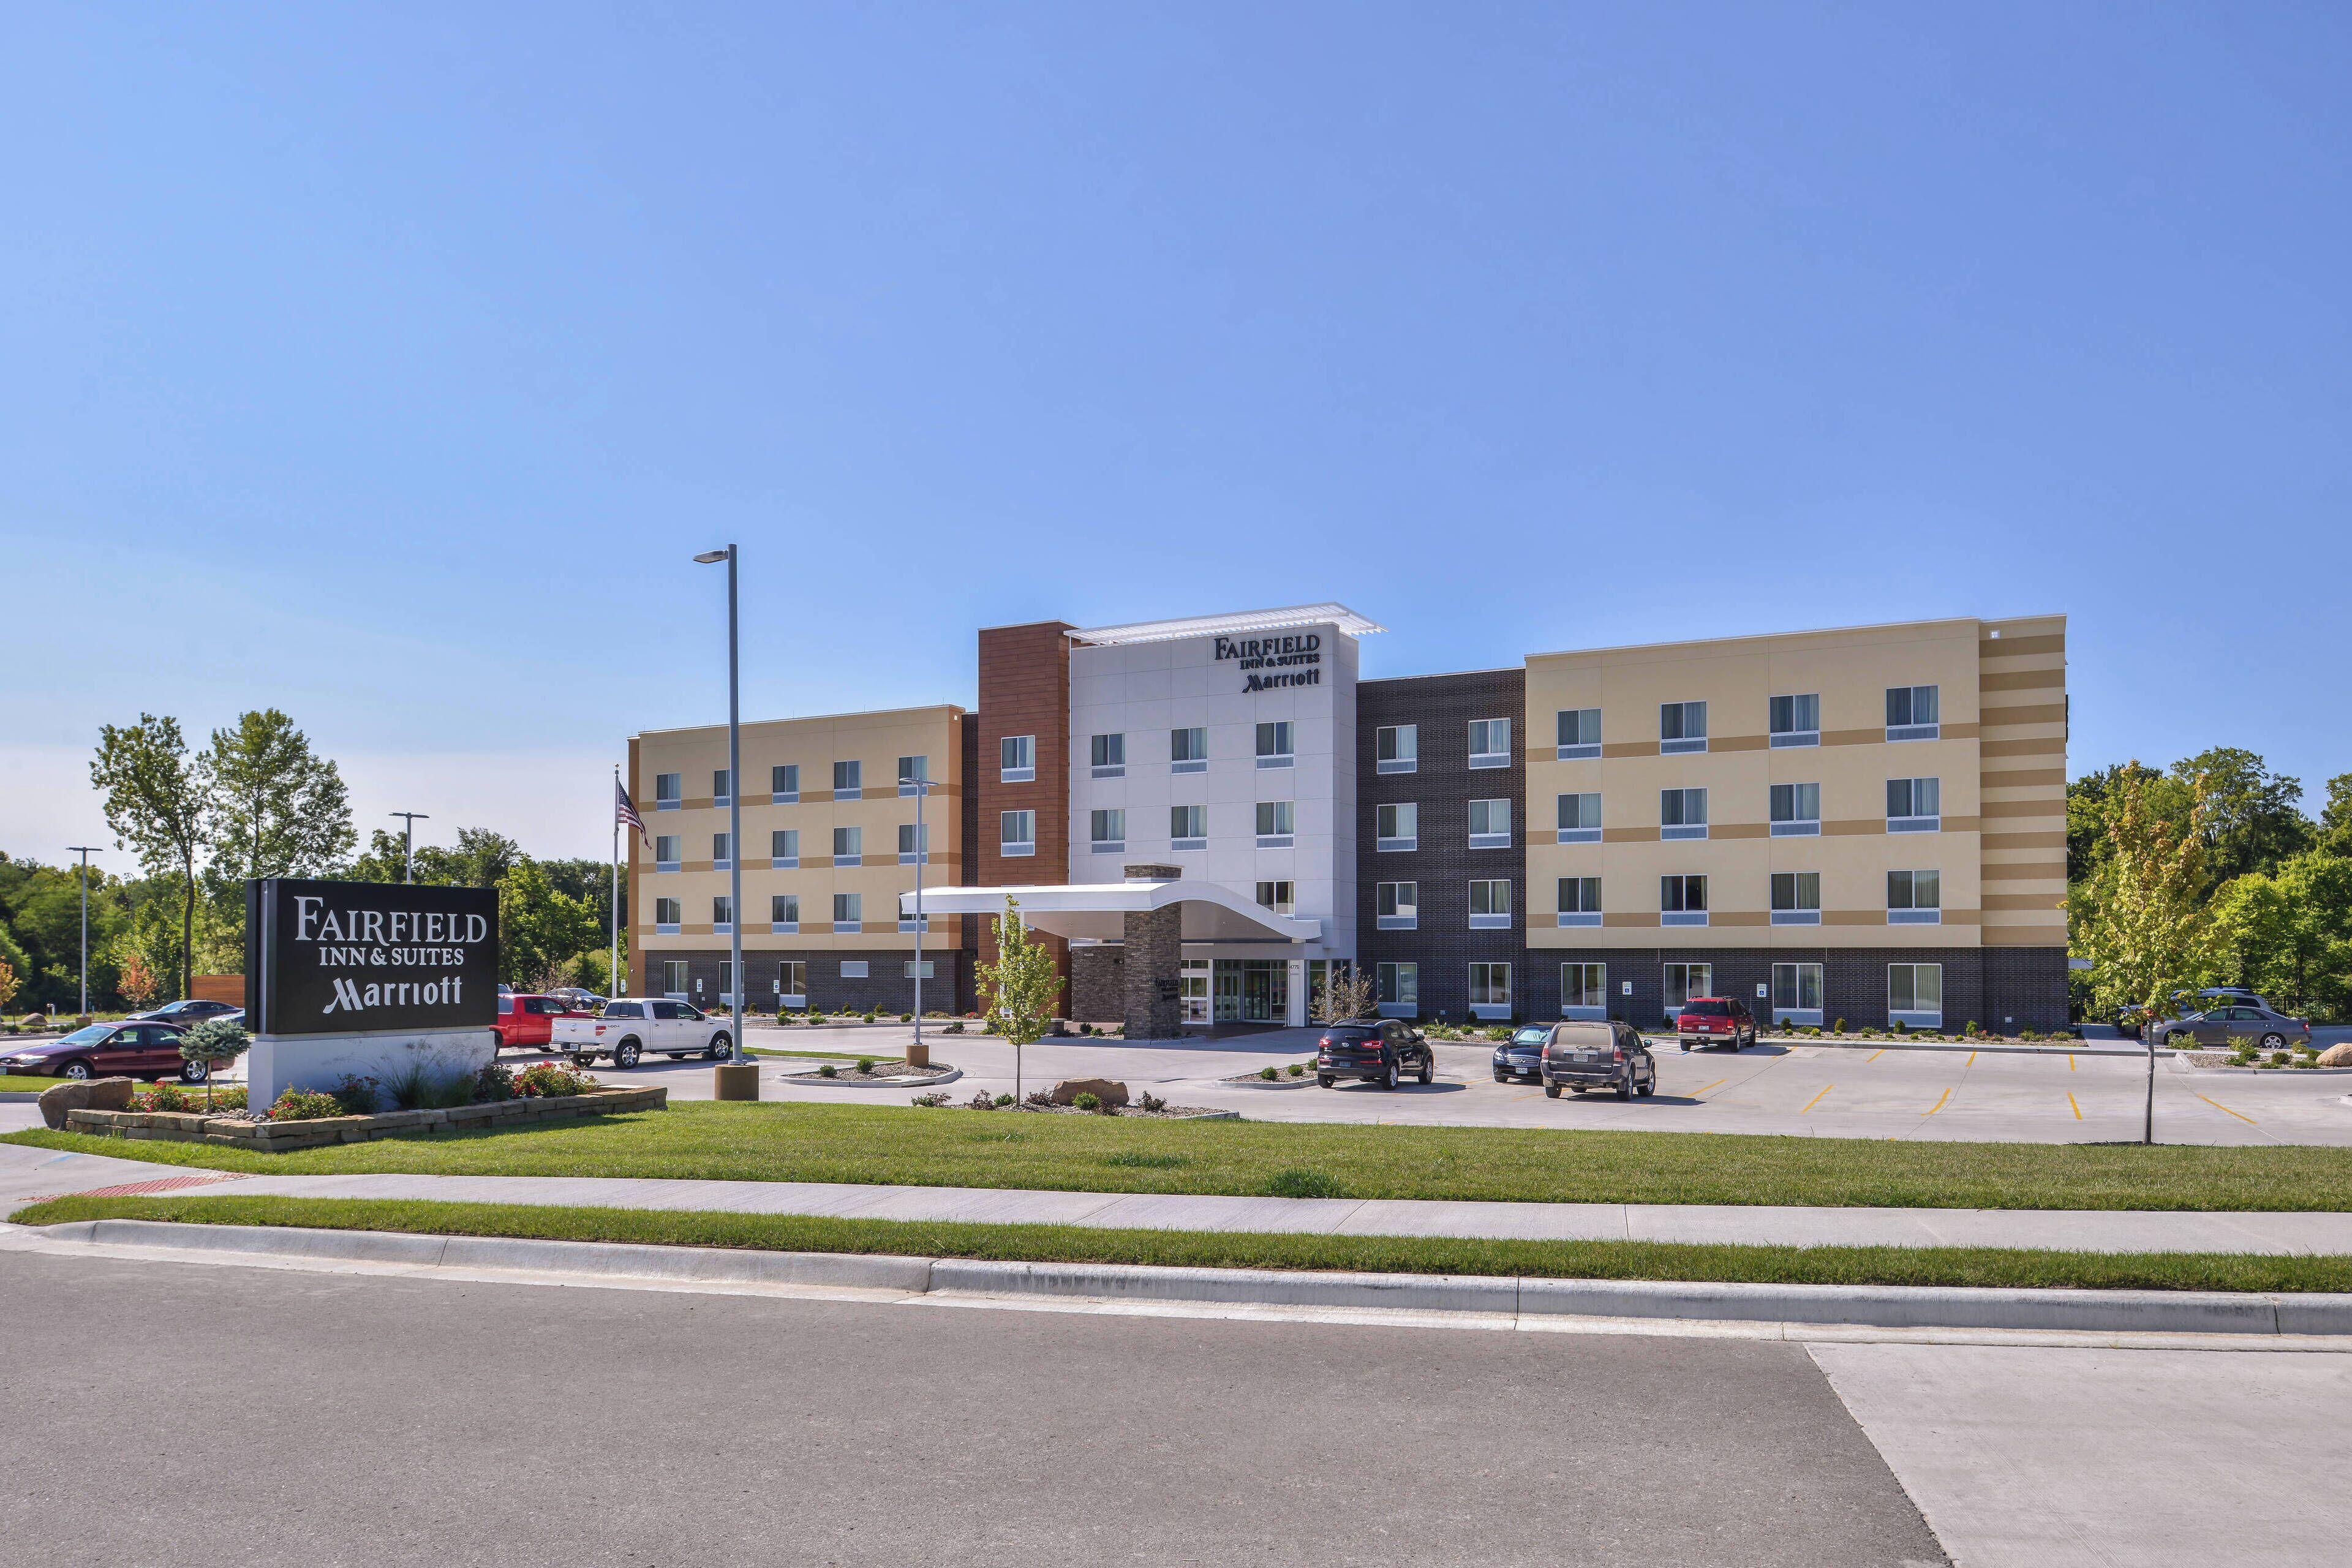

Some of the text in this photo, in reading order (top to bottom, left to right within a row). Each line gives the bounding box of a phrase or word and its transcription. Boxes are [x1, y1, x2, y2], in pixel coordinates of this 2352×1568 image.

[1214, 635, 1321, 660] FAIRFIELD
[1240, 658, 1264, 670] INN
[1277, 653, 1321, 666] SUITES
[1242, 668, 1320, 693] Marriott
[294, 896, 487, 946] FAIRFIELD
[319, 947, 366, 966] INN
[391, 948, 464, 966] SUITES
[322, 976, 462, 1014] Marriott
